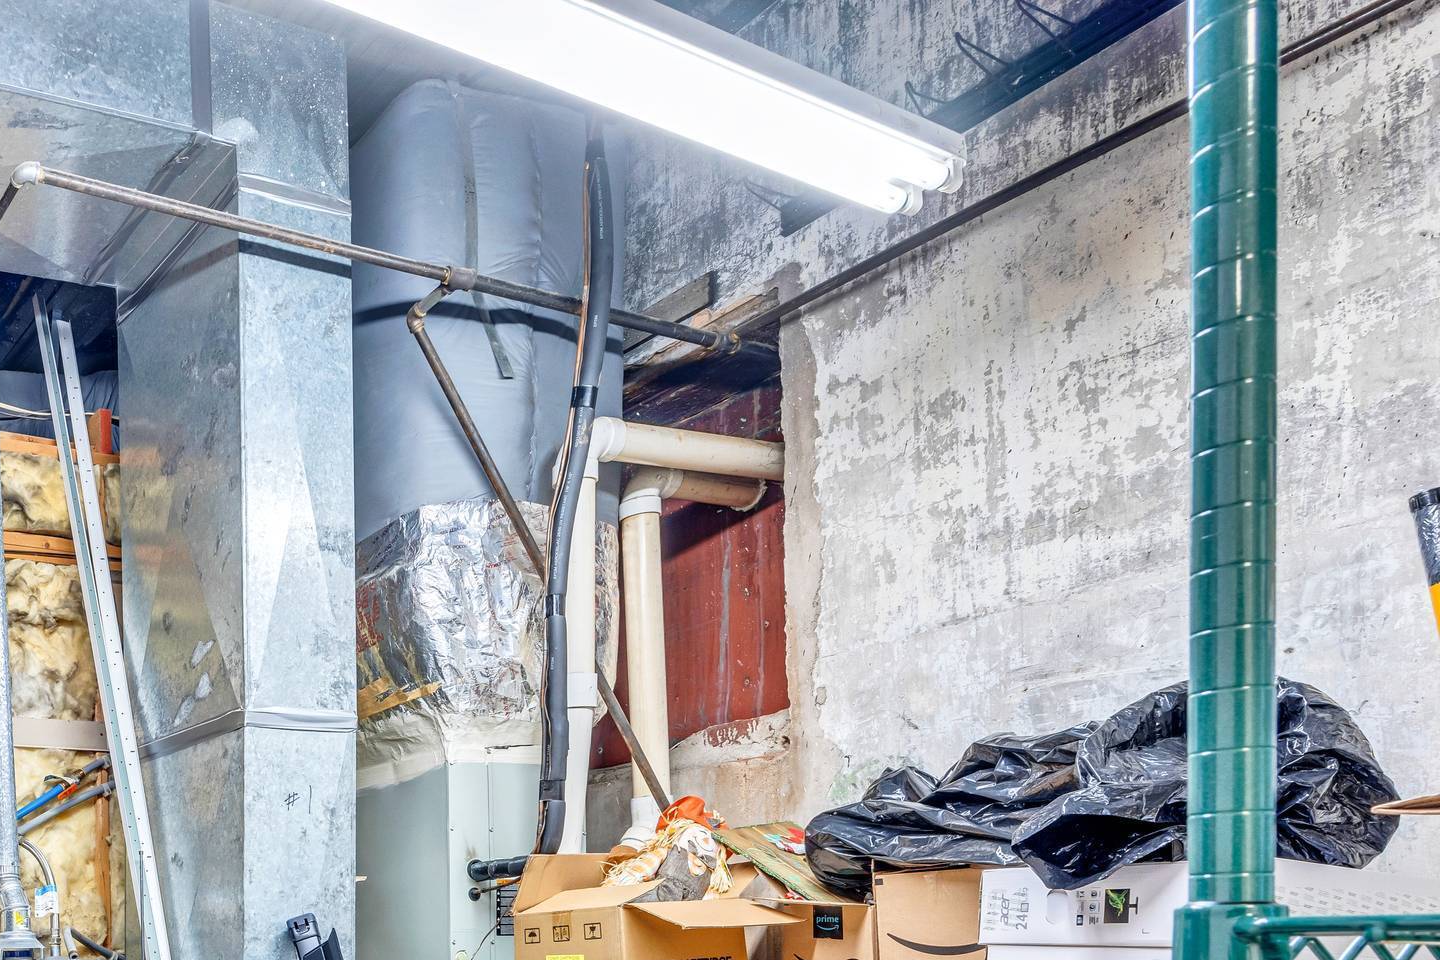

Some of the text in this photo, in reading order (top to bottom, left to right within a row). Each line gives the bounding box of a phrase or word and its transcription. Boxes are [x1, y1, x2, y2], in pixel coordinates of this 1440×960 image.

[1000, 897, 1010, 925] acer
[816, 915, 839, 924] prime
[1016, 914, 1028, 930] 24
